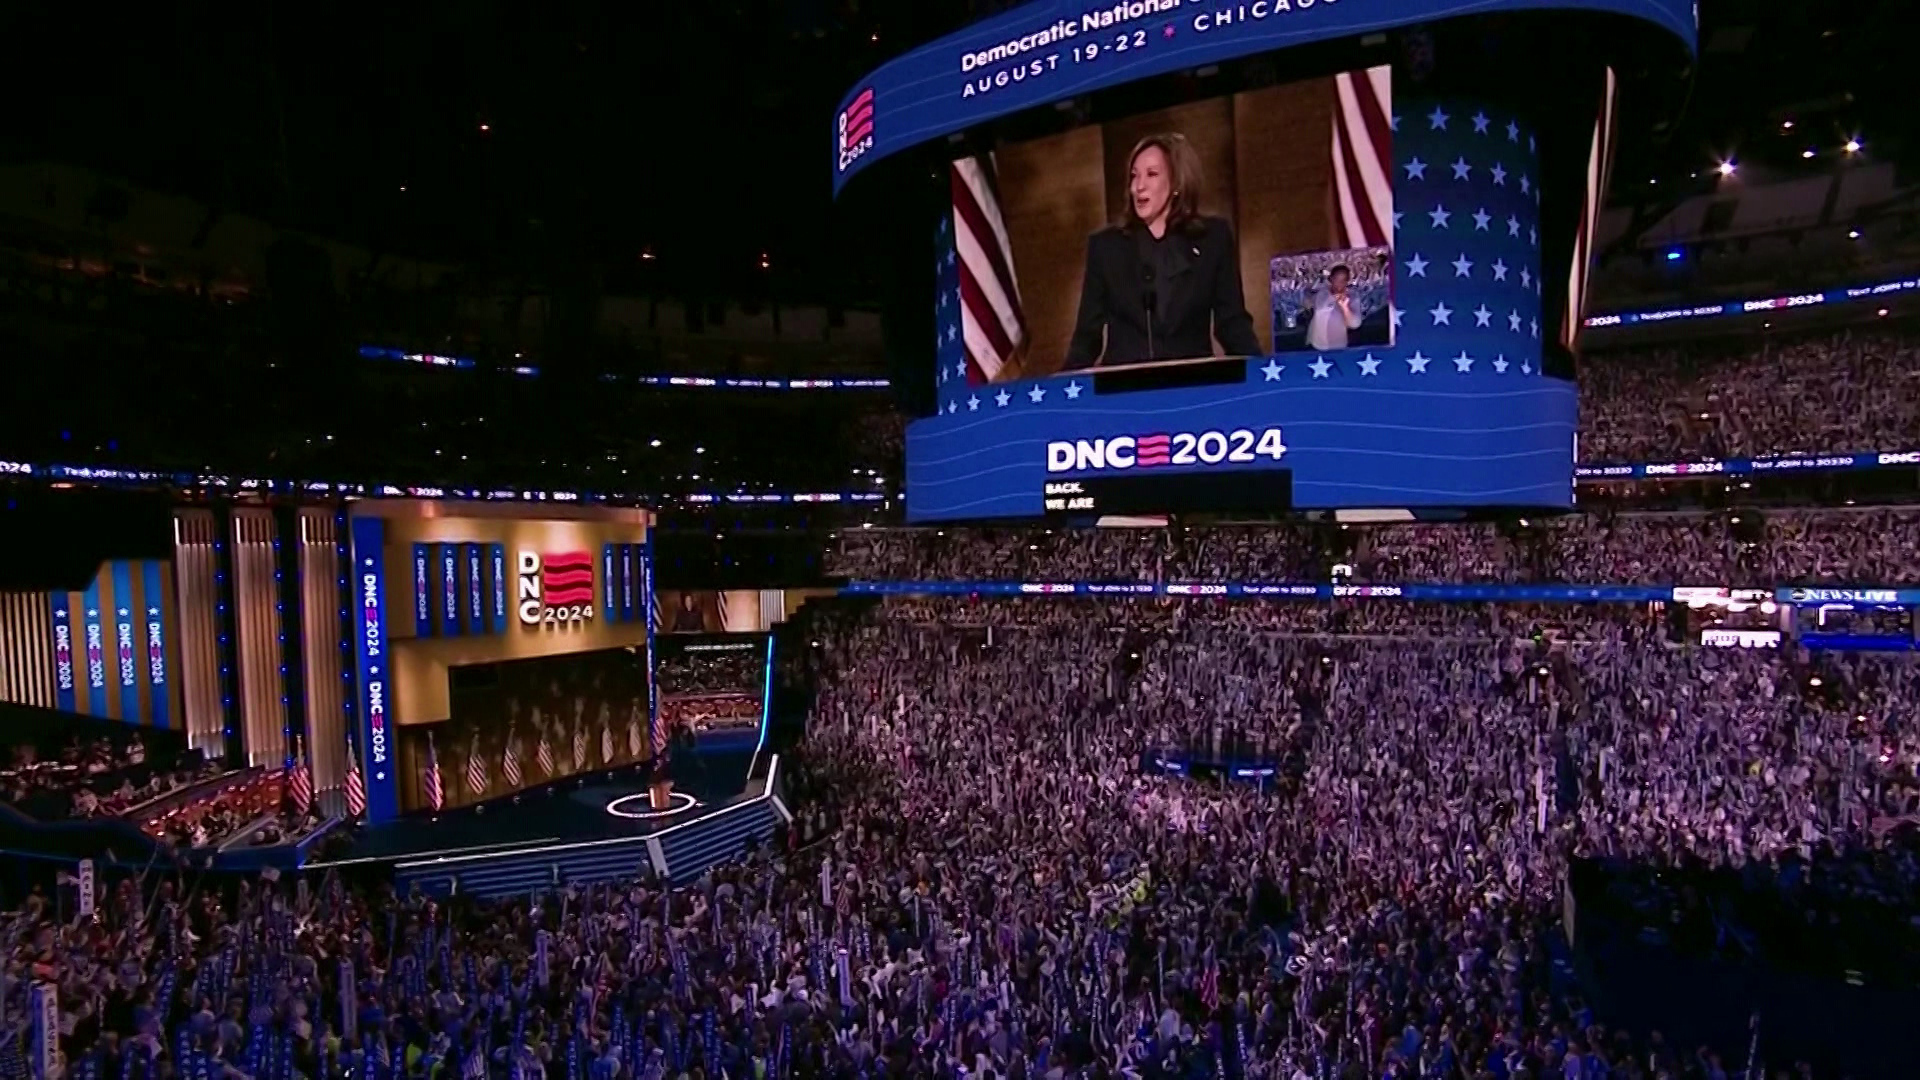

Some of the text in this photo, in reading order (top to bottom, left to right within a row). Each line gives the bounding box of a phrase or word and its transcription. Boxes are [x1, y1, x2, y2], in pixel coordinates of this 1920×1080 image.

[962, 20, 1077, 72] Democratic
[962, 54, 1060, 98] AUGUST
[1073, 30, 1147, 64] 19-22
[1744, 293, 1824, 312] DNC 2024
[1047, 428, 1287, 472] DNC 2024
[1878, 452, 1920, 465] DNC
[1646, 462, 1723, 475] DNC 2024
[1775, 459, 1801, 468] JOIN
[1045, 498, 1095, 510] WE ARE
[518, 551, 541, 624] DNC
[1805, 588, 1854, 601] NEWS
[1854, 590, 1898, 602] LIVE
[363, 574, 380, 656] DNC 2024
[545, 605, 593, 623] 2024
[369, 681, 386, 763] DNC 2024
